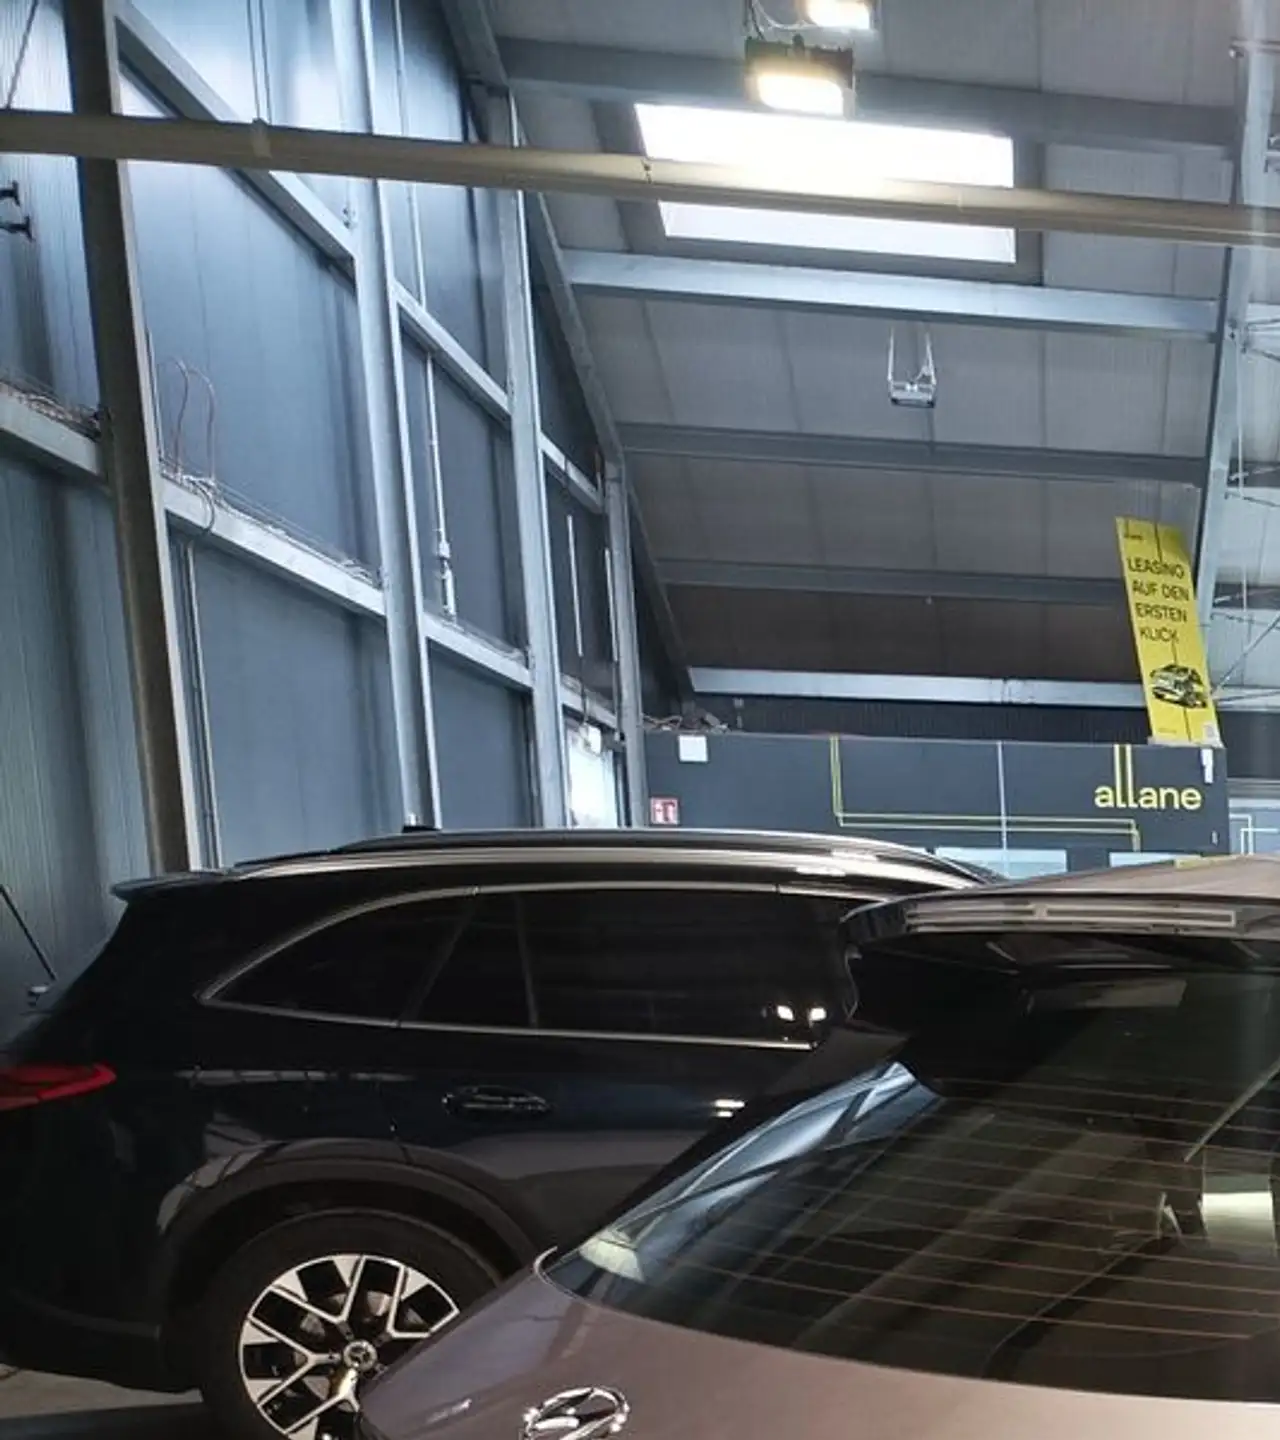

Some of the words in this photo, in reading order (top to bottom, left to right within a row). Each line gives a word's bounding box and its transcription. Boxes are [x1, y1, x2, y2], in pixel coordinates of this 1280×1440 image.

[1132, 580, 1158, 596] AUF
[1161, 583, 1190, 602] DEN
[1135, 602, 1187, 623] ERSTEN
[1140, 626, 1179, 644] KLICK
